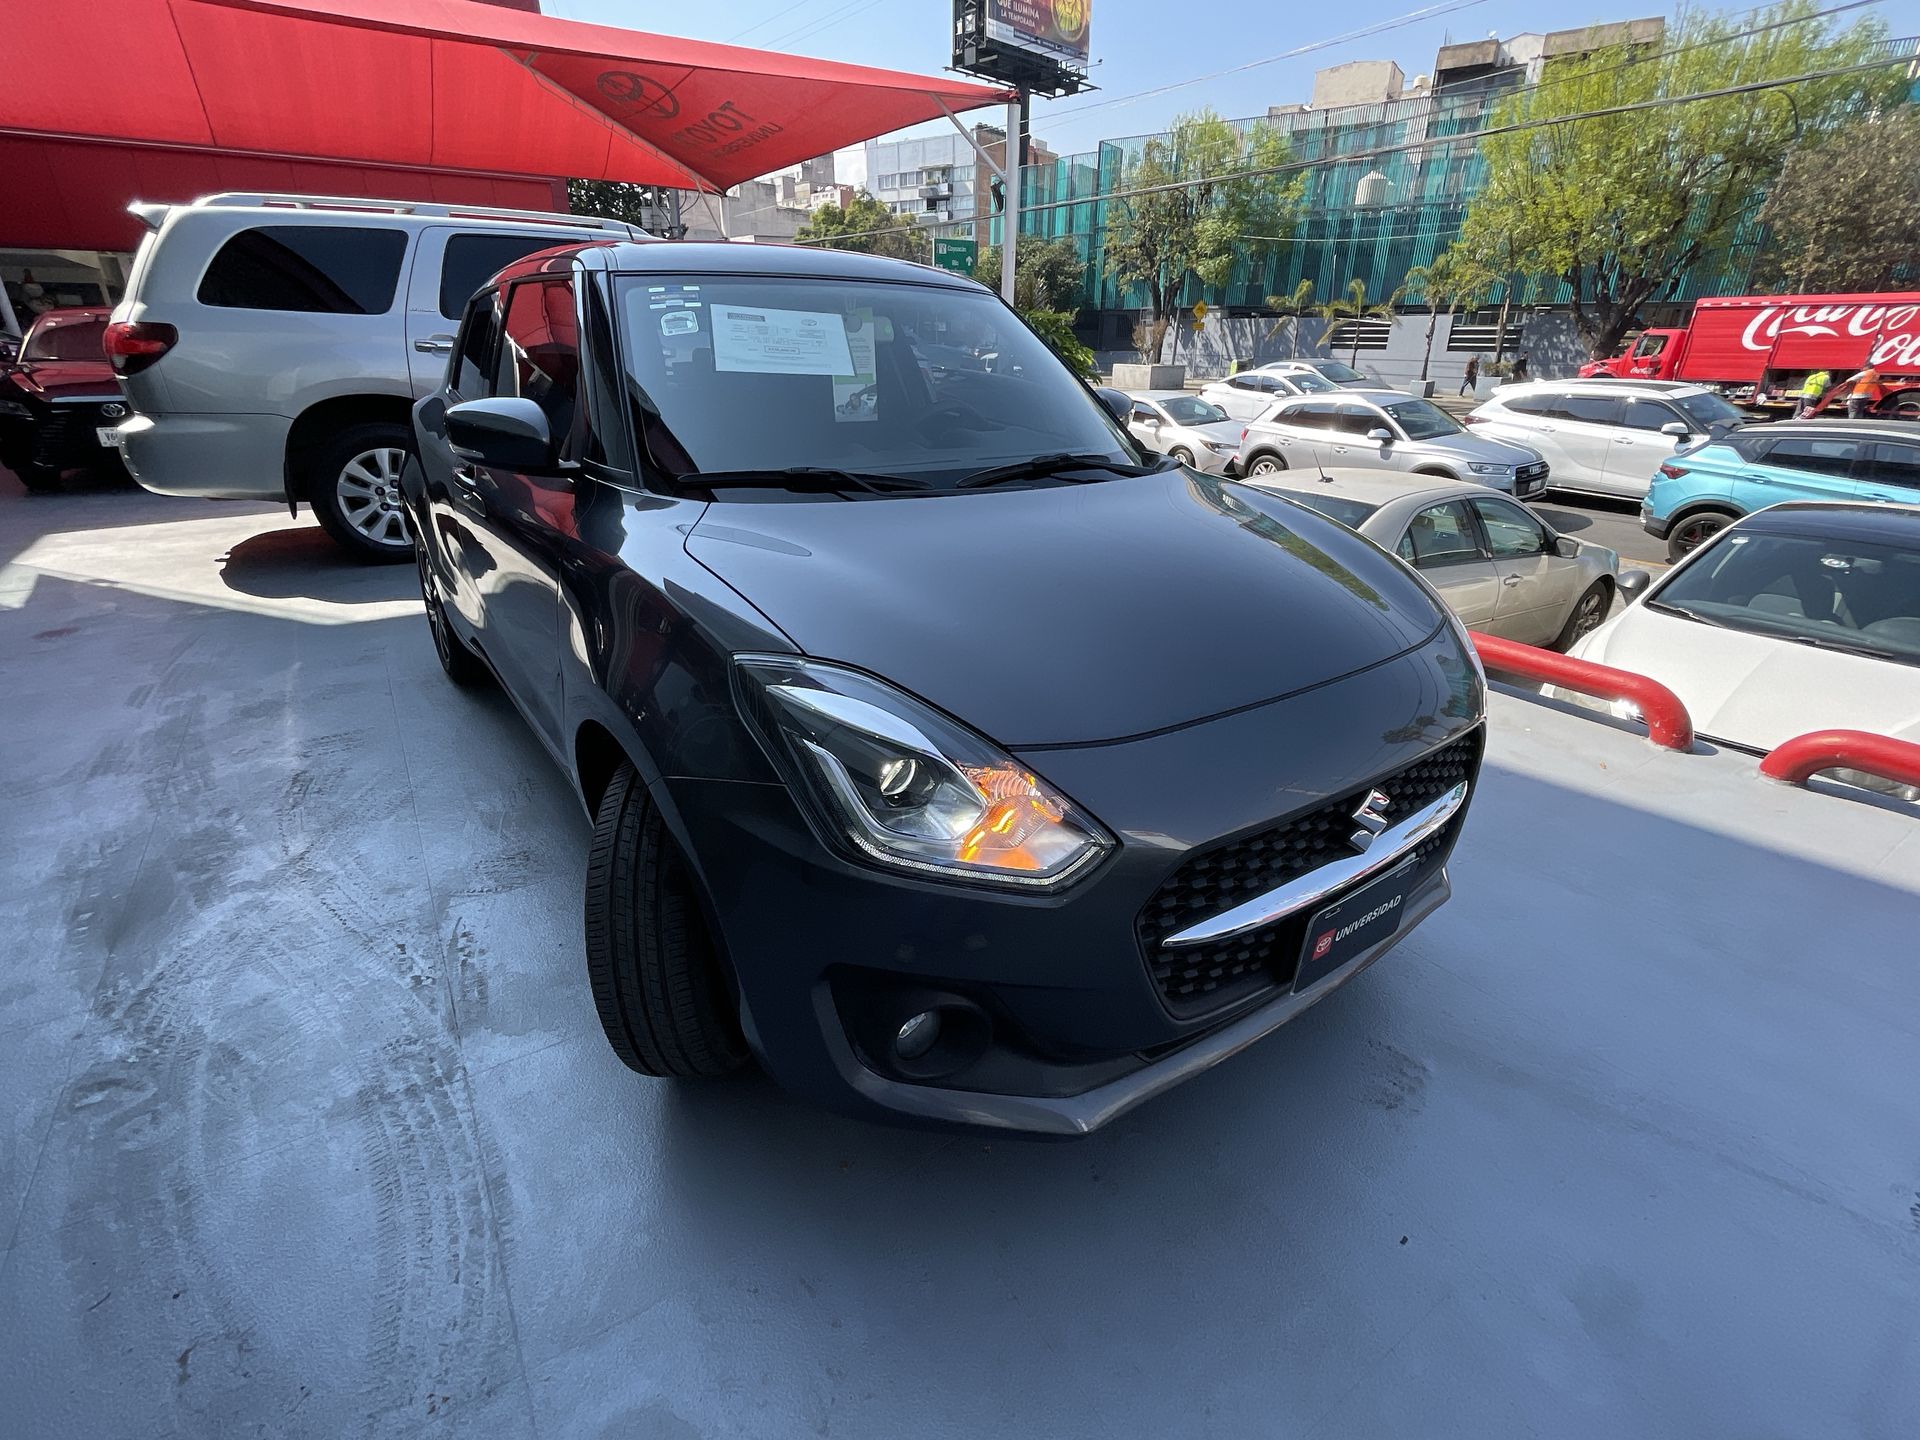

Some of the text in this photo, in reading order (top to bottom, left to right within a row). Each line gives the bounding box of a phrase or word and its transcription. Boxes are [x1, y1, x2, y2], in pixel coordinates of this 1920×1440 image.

[1000, 9, 1036, 29] LA TEMPORADA
[1013, 1, 1040, 20] ILUMINA
[1335, 894, 1402, 942] UNIVERSIDAD
